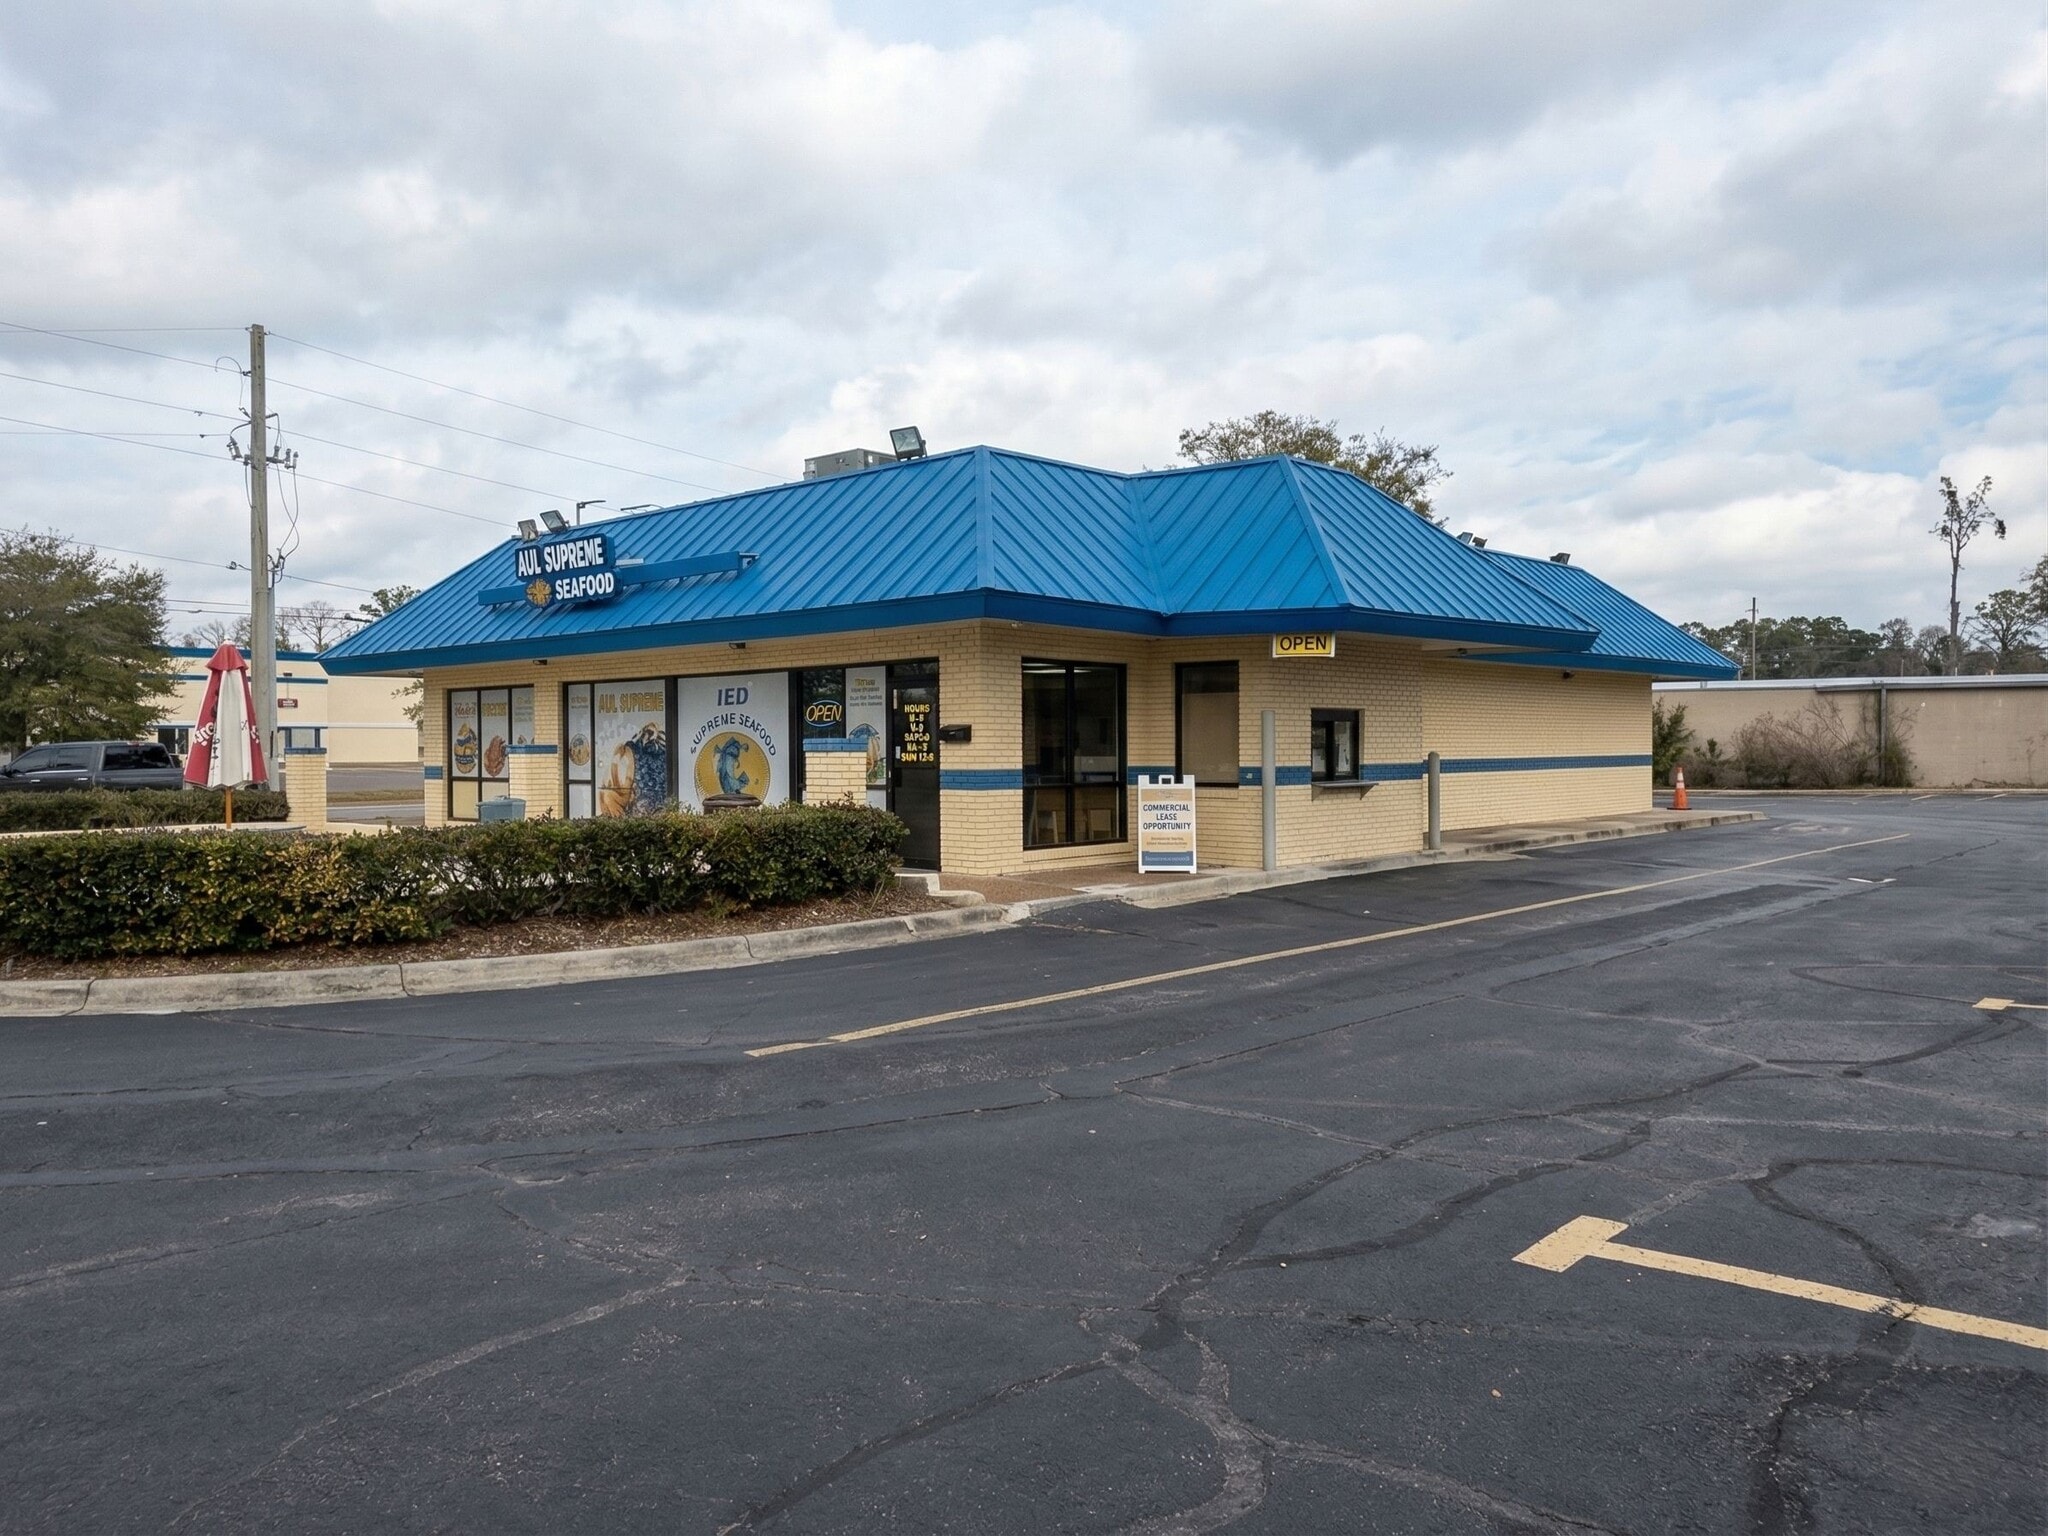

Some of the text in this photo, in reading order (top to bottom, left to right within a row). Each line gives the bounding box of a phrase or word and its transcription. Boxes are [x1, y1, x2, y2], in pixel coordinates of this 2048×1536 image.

[518, 537, 604, 577] AUL SUPREME
[555, 572, 614, 600] SEAFOOD
[1280, 636, 1327, 651] OPEN
[620, 691, 664, 713] SUPREME
[717, 687, 749, 706] IED
[806, 704, 842, 722] OPEN
[904, 704, 930, 713] HOURS
[690, 713, 776, 756] SUPREME SEAFOOD
[901, 753, 917, 762] SUN
[1143, 804, 1190, 812] COMMERCIAL
[1143, 822, 1191, 830] OPPORTUNITY
